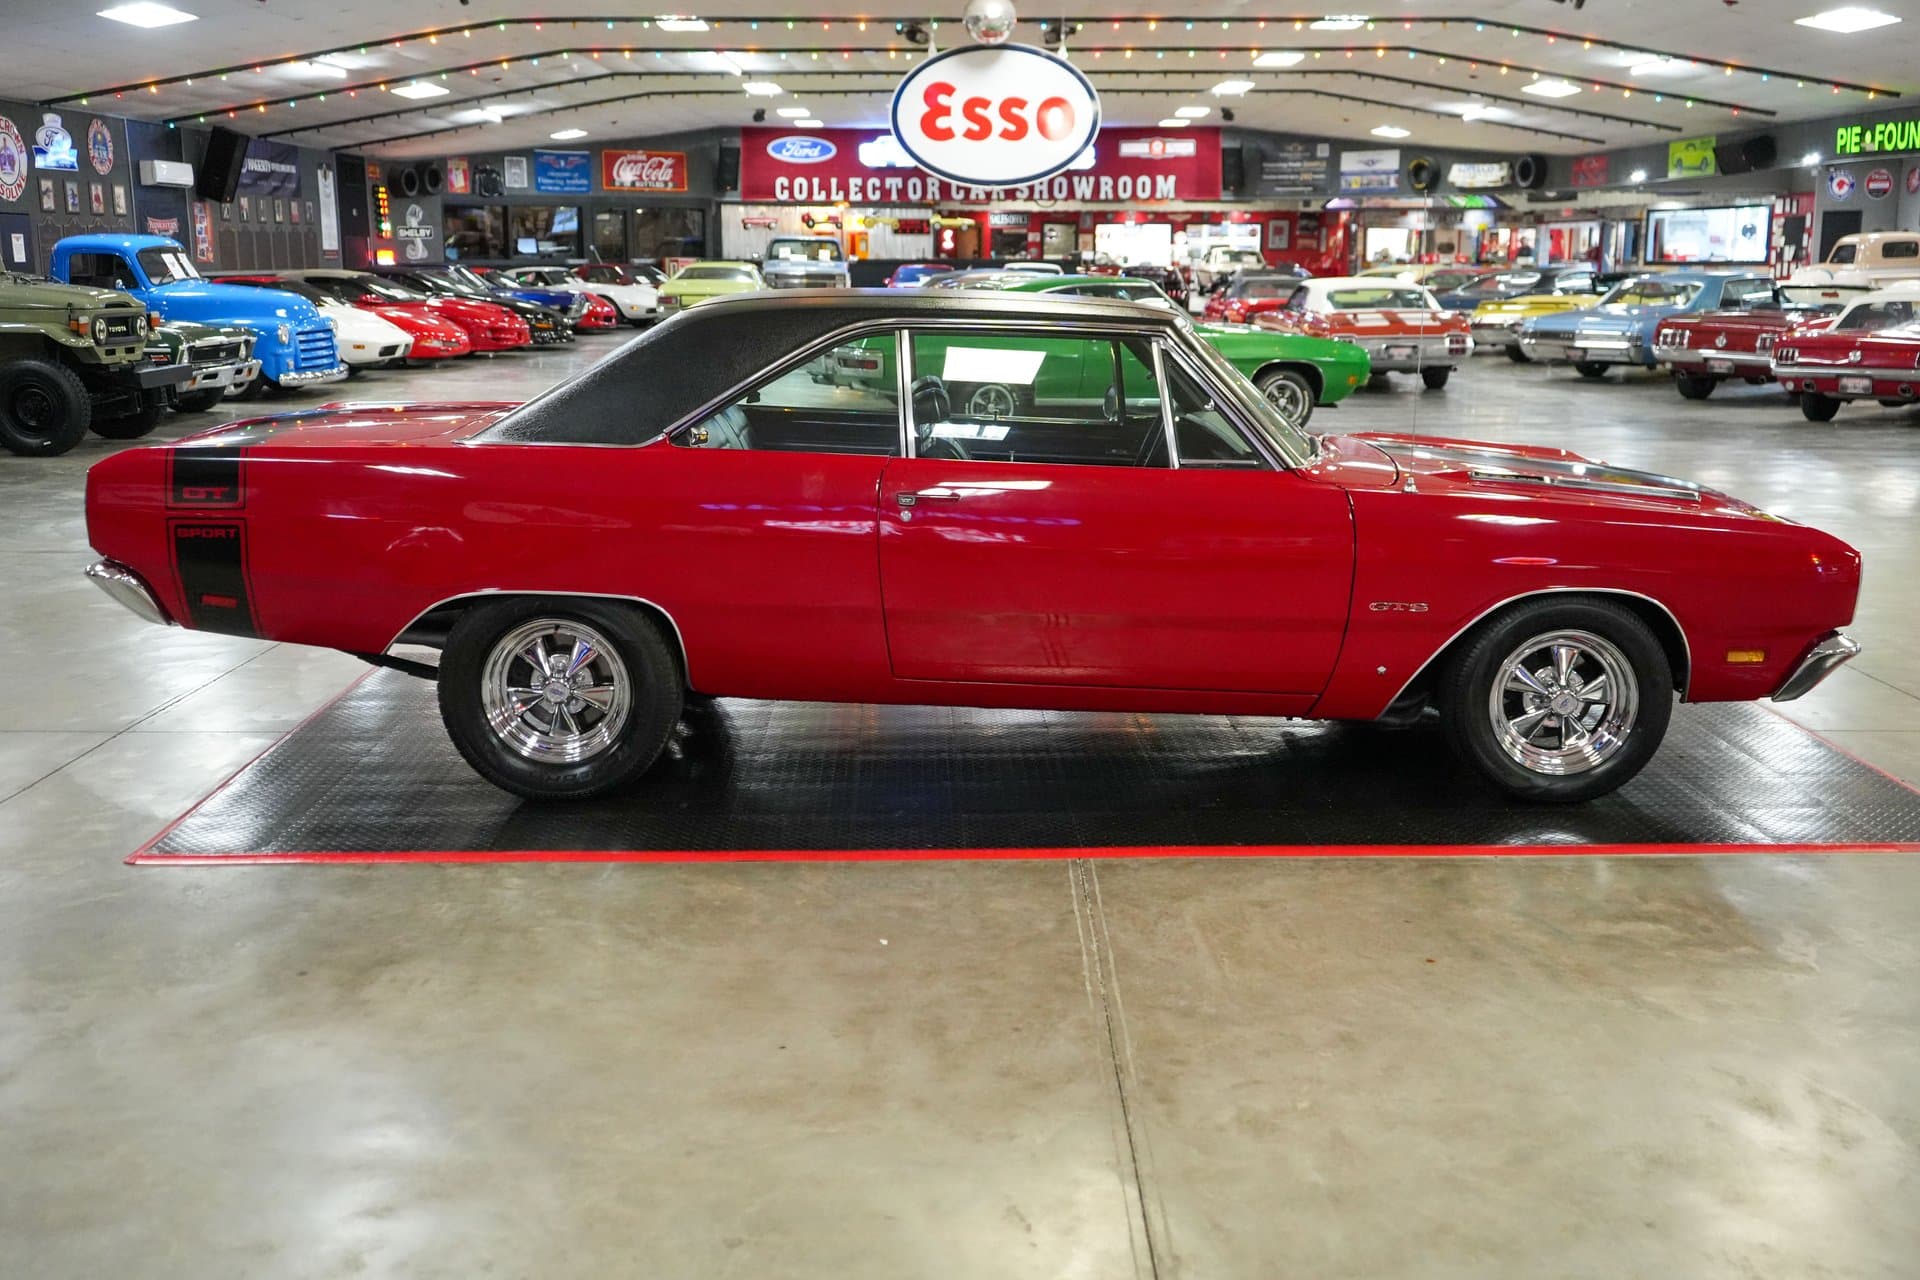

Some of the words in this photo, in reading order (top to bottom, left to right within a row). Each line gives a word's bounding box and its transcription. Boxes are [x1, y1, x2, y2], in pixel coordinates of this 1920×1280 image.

[1836, 125, 1861, 154] PIE
[782, 141, 822, 156] Ford
[775, 176, 941, 201] COLLECTOR
[951, 181, 1005, 200] CAR
[1015, 175, 1176, 200] SHOWROOM
[399, 228, 431, 237] SHELBY
[177, 527, 238, 539] SPORT
[1368, 601, 1429, 612] GTS
